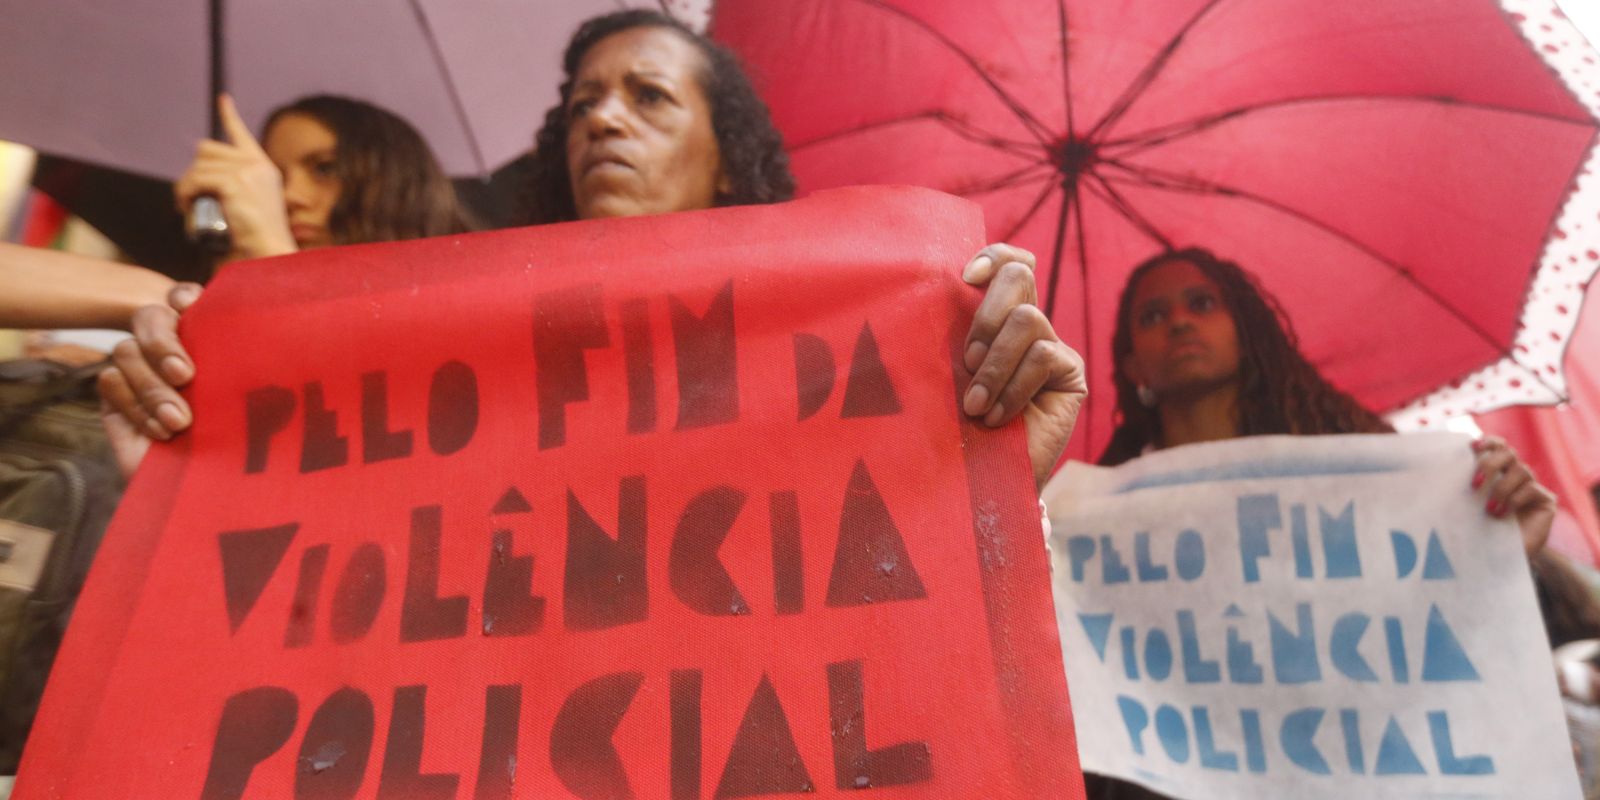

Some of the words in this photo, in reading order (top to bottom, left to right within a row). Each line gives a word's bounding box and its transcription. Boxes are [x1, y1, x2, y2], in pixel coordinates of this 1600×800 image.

[244, 360, 480, 474] PELO
[531, 277, 739, 451] FIM
[791, 320, 902, 422] DA
[217, 456, 928, 648] VIOLÊNCIA
[1067, 528, 1206, 584] PELO
[1236, 493, 1363, 583] FIM
[1388, 528, 1455, 580] DA
[1077, 602, 1483, 684] VIOLÊNCIA
[202, 659, 934, 800] POLICIAL
[1116, 694, 1497, 776] POLICIAL
